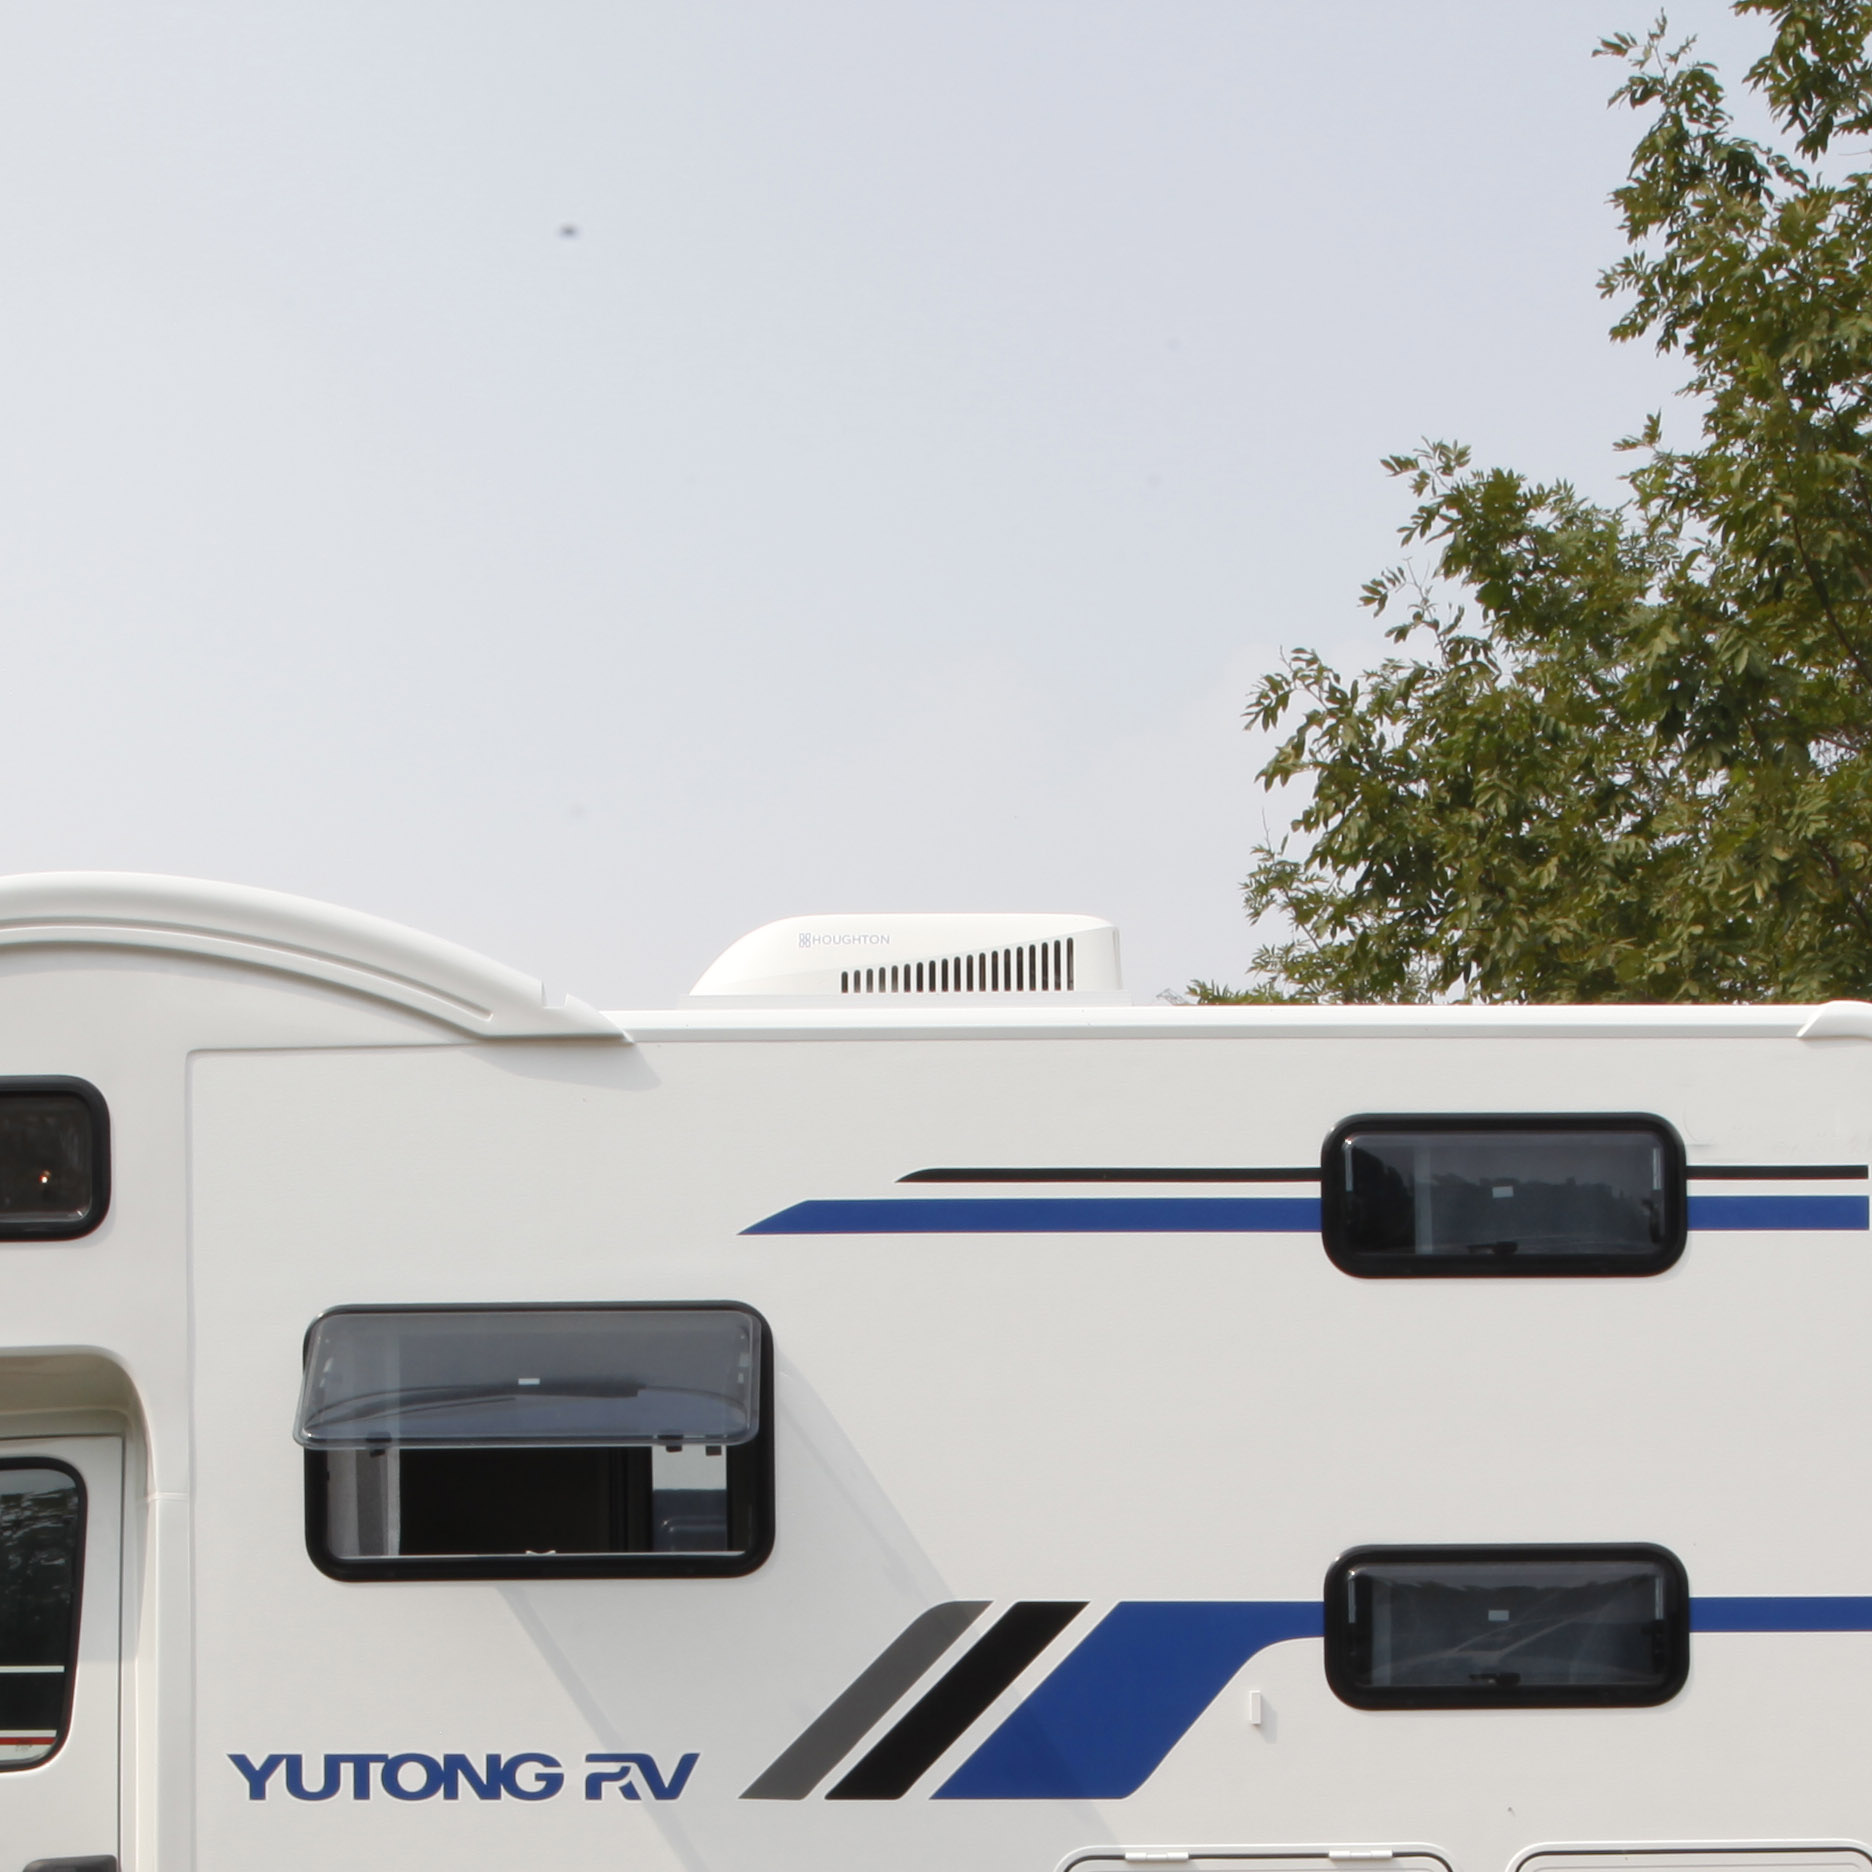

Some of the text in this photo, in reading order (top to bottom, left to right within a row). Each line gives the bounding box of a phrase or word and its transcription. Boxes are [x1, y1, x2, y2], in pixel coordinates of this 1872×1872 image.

[812, 934, 890, 945] HOUGHTON
[227, 1753, 701, 1801] YUTONG RV
